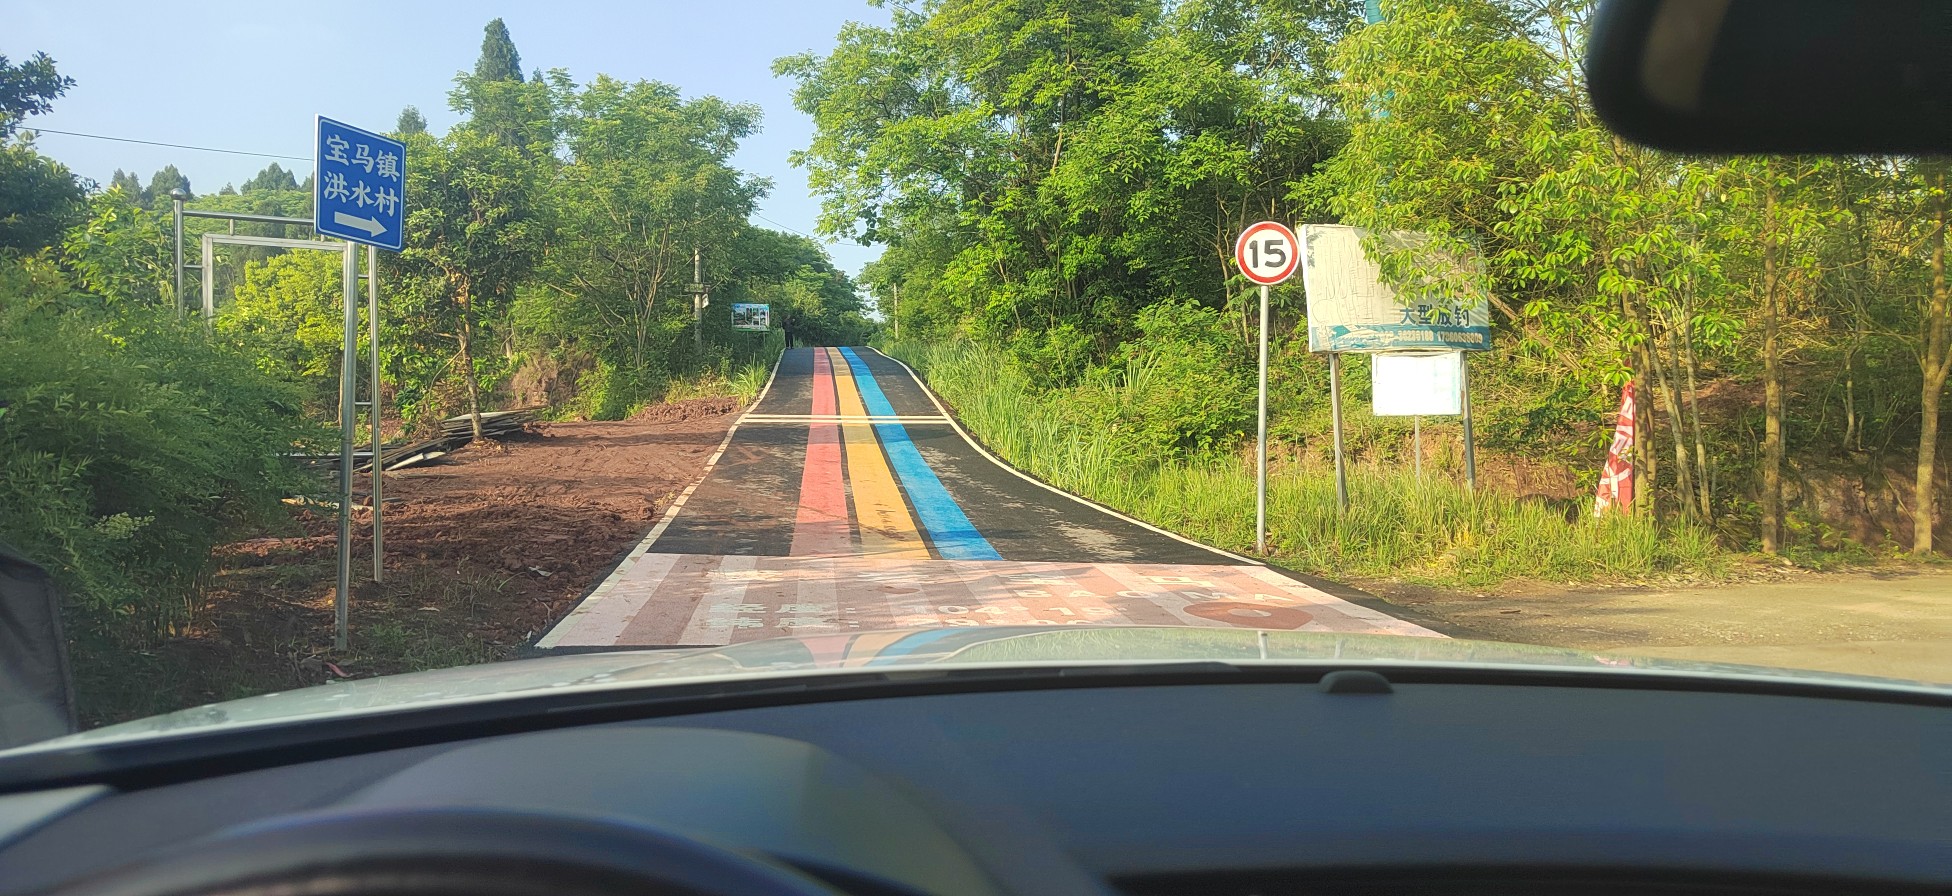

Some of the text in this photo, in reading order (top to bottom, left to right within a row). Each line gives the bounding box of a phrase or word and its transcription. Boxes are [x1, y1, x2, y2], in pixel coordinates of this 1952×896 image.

[324, 134, 400, 183] 宝马镇
[323, 170, 399, 217] 洪水村
[1249, 239, 1286, 268] 15
[1013, 589, 1294, 602] BAOMA
